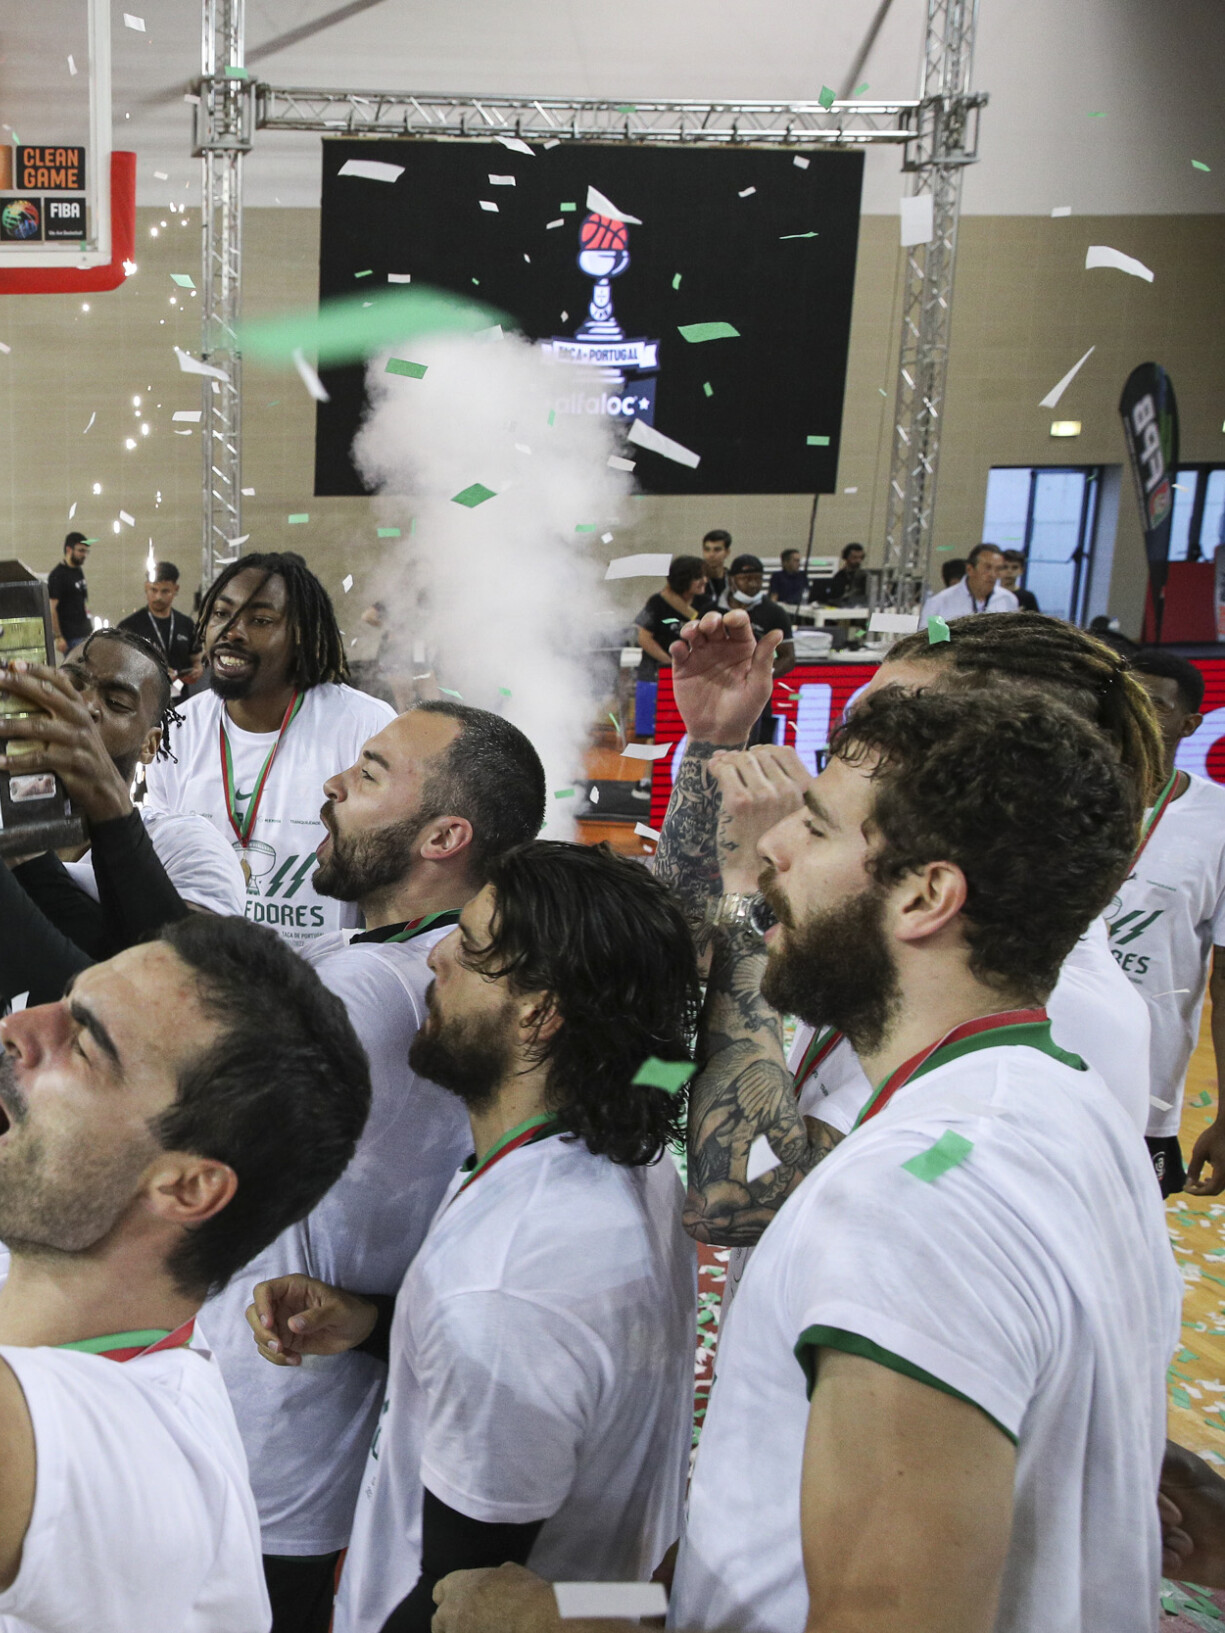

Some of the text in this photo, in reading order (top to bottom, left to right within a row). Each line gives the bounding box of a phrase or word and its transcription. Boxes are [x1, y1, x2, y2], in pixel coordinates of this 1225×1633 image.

[23, 148, 79, 167] CLEAN
[23, 168, 79, 188] GAME
[50, 203, 80, 218] FIBA
[589, 348, 638, 361] PORTUGAL
